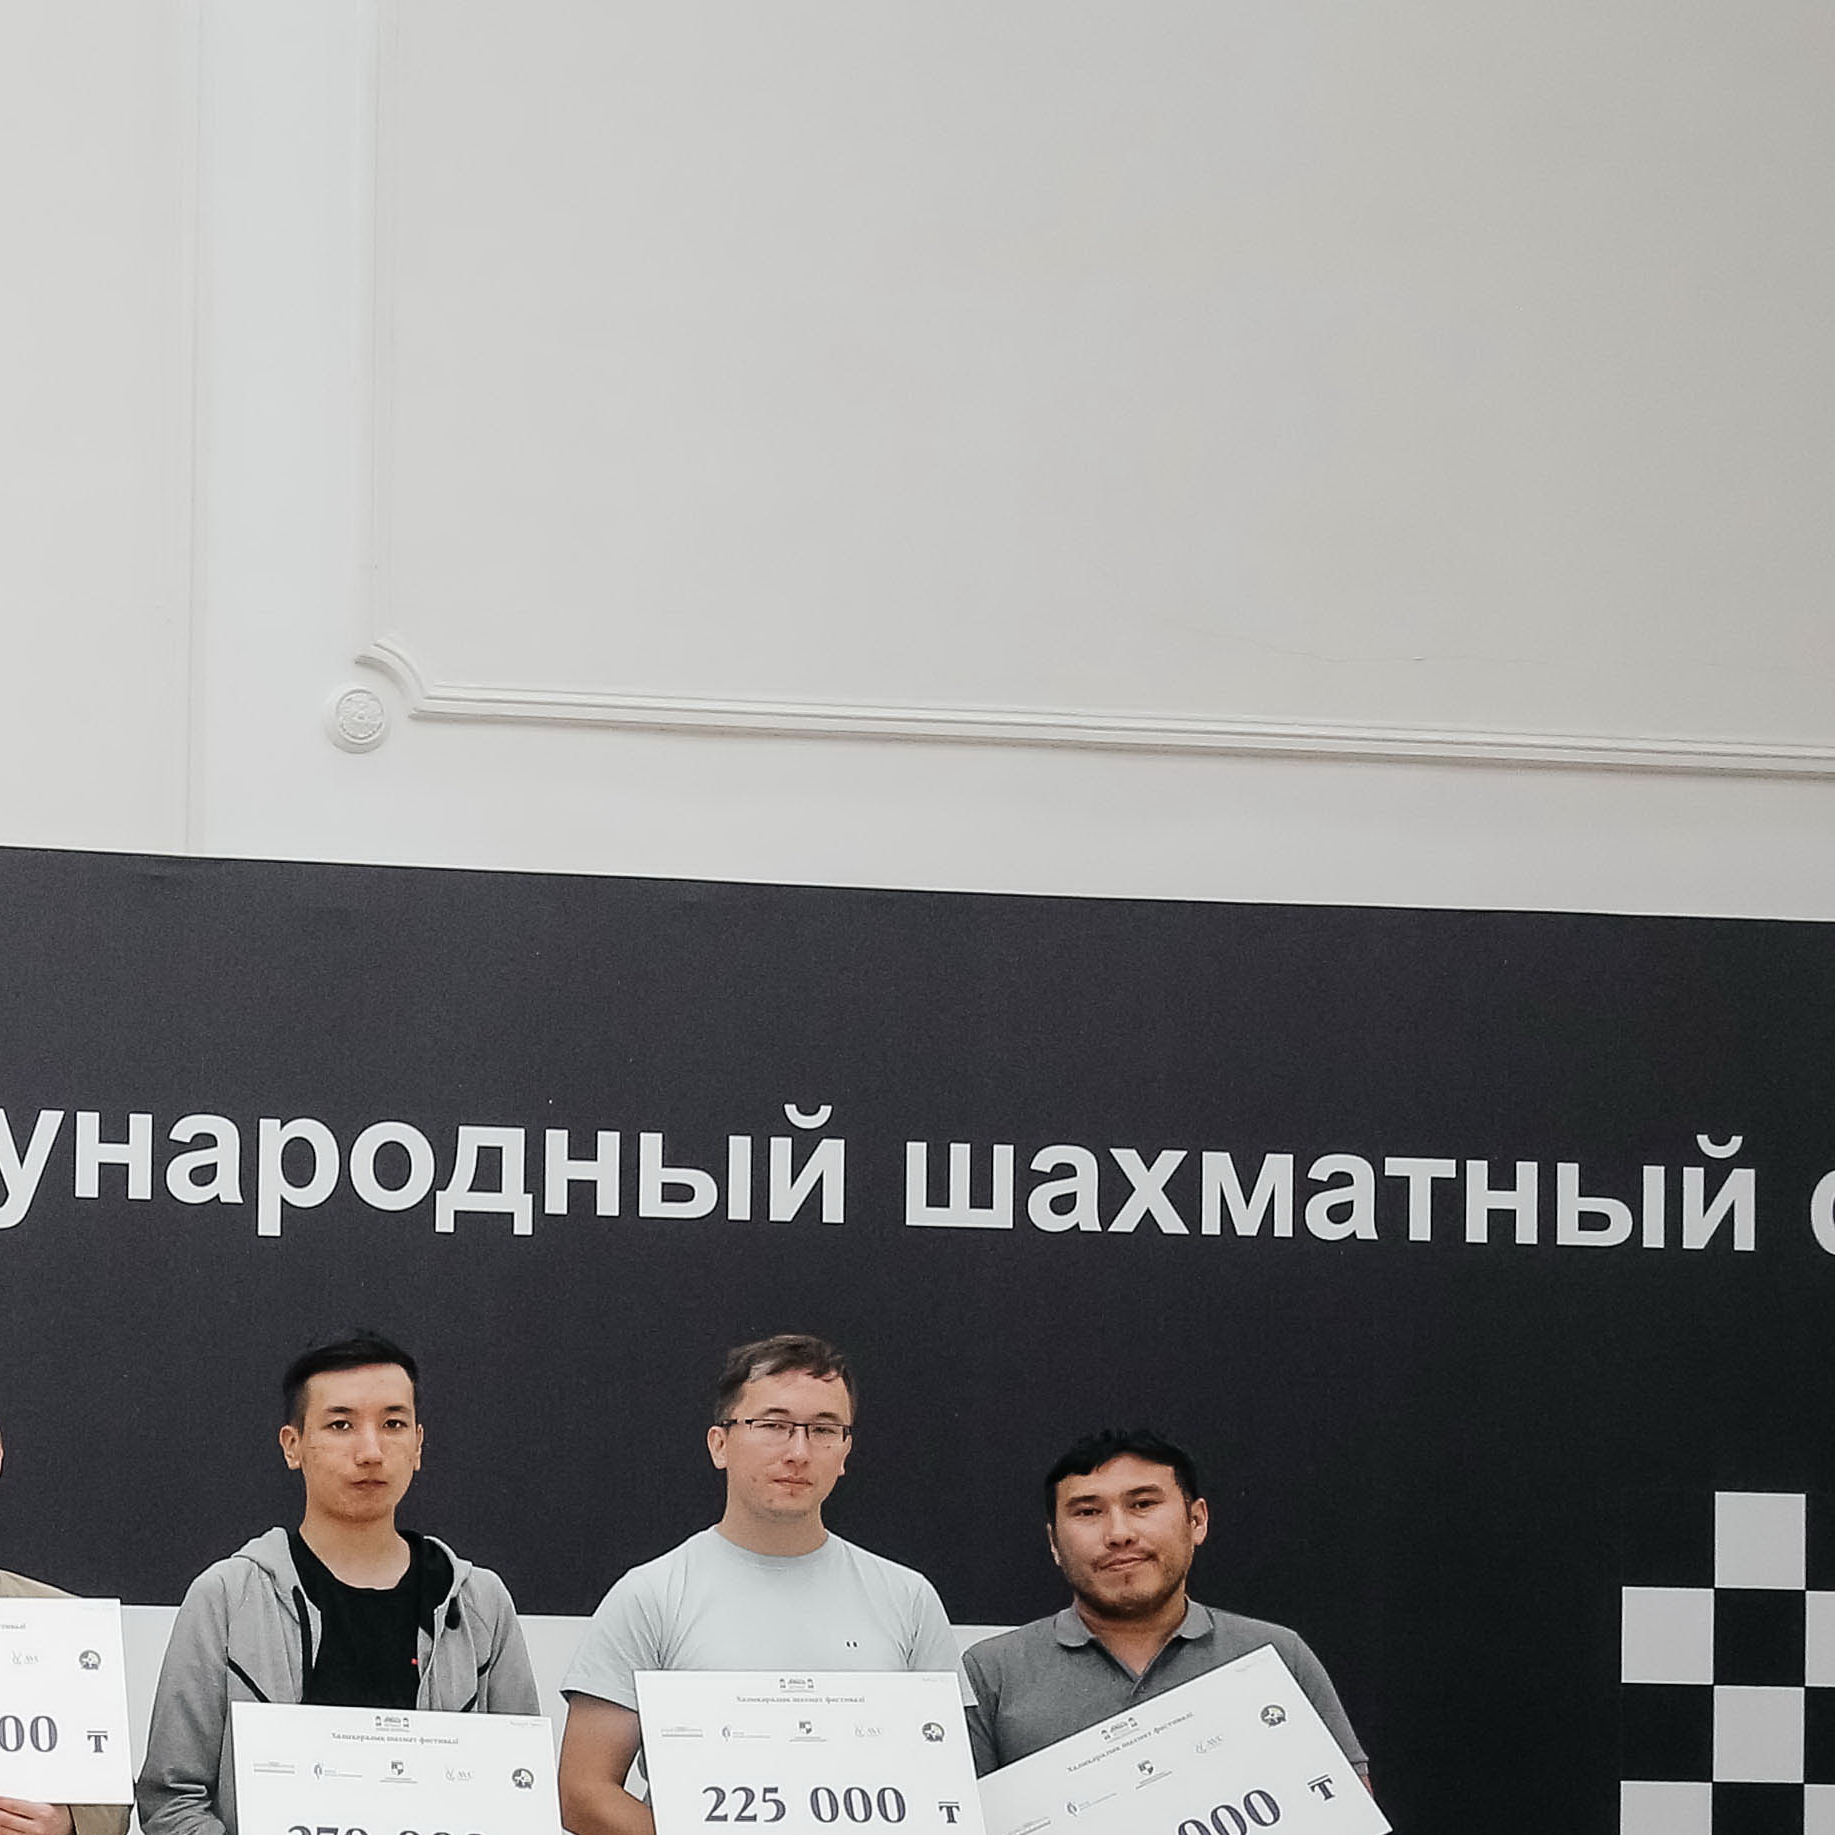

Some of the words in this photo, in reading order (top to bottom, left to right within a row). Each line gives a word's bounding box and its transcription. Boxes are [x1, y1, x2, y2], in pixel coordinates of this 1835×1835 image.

[905, 1134, 1756, 1251] шахматный
[702, 1786, 786, 1823] 225
[810, 1787, 906, 1824] 000
